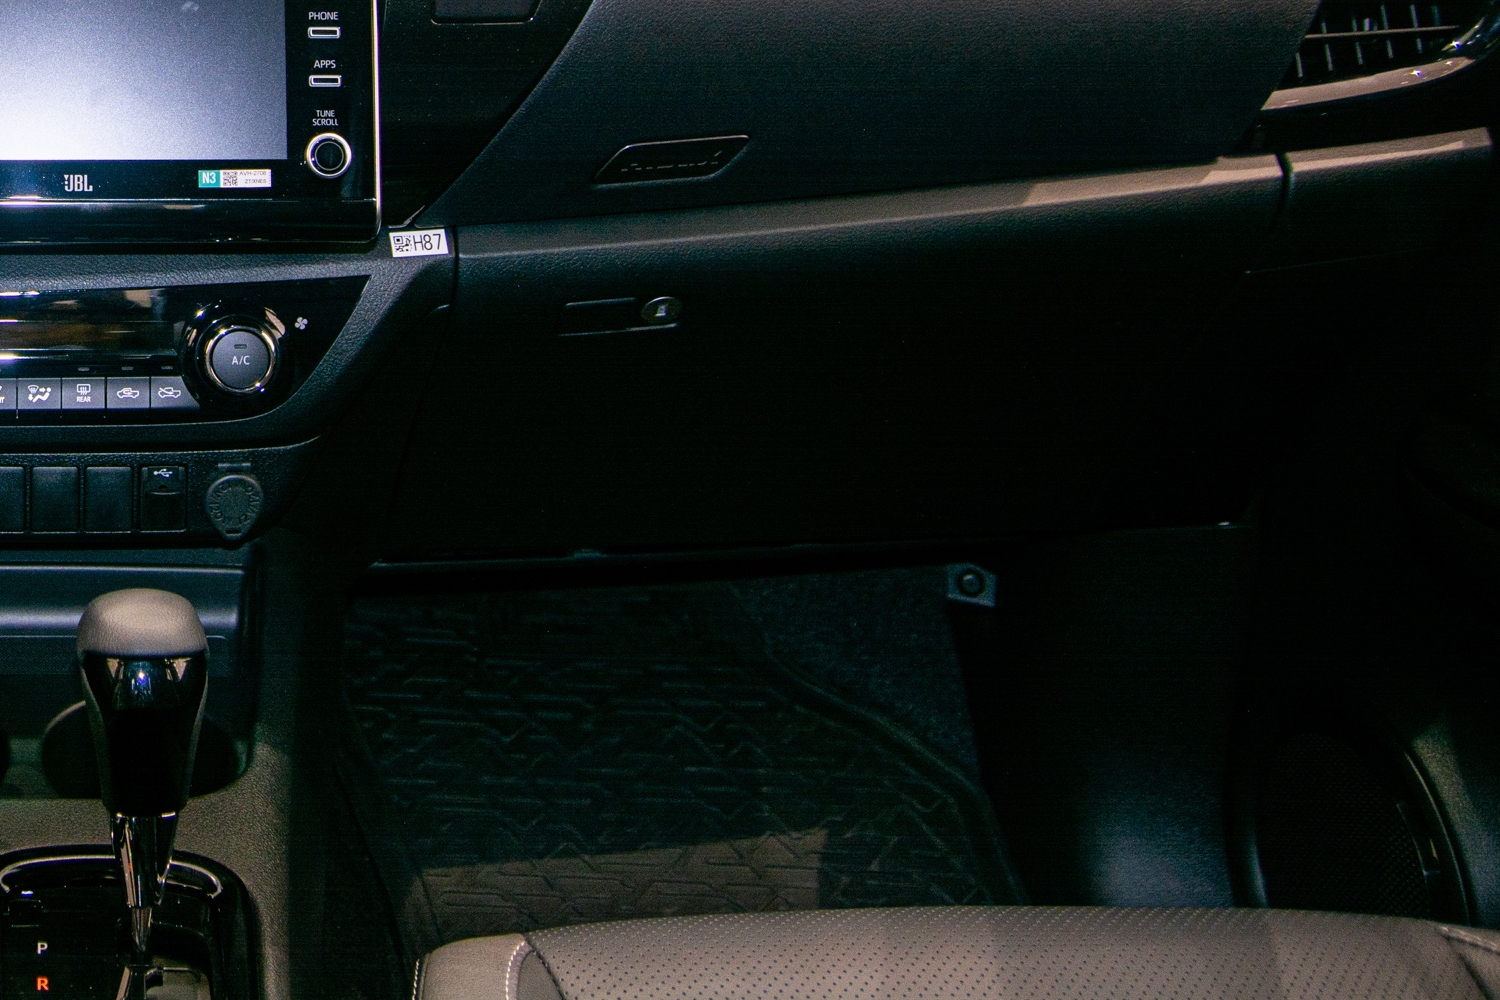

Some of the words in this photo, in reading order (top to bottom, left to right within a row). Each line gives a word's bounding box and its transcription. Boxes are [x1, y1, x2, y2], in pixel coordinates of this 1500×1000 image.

[308, 12, 339, 21] PHONE
[313, 60, 336, 68] APPS
[316, 110, 335, 118] TUNE
[312, 118, 339, 126] SCROLL
[64, 174, 94, 192] JBL
[202, 171, 217, 184] N3
[412, 233, 441, 251] H87
[231, 355, 251, 366] A/C
[37, 942, 48, 955] P
[36, 977, 49, 991] R
